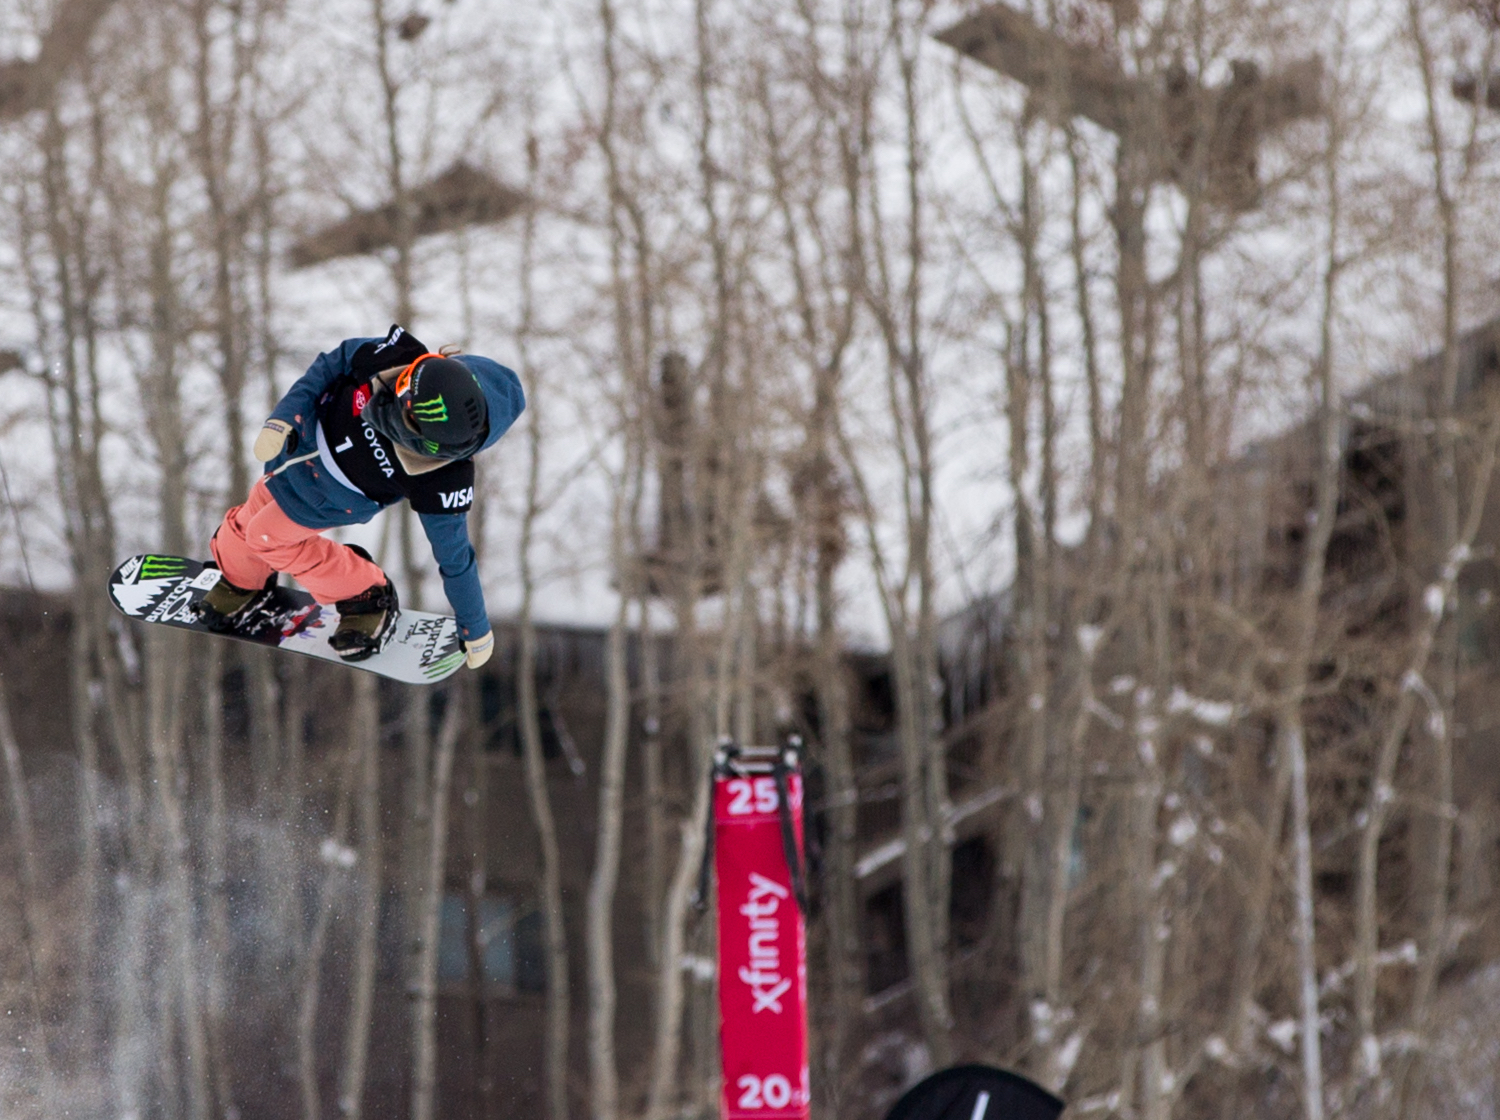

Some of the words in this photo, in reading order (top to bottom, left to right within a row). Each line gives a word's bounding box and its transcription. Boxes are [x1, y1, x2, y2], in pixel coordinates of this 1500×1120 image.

[335, 436, 354, 454] 1
[438, 486, 474, 509] VISA
[145, 577, 193, 622] BURTON
[419, 617, 446, 669] BURTON
[727, 779, 780, 815] 25
[738, 873, 791, 1013] xfinity
